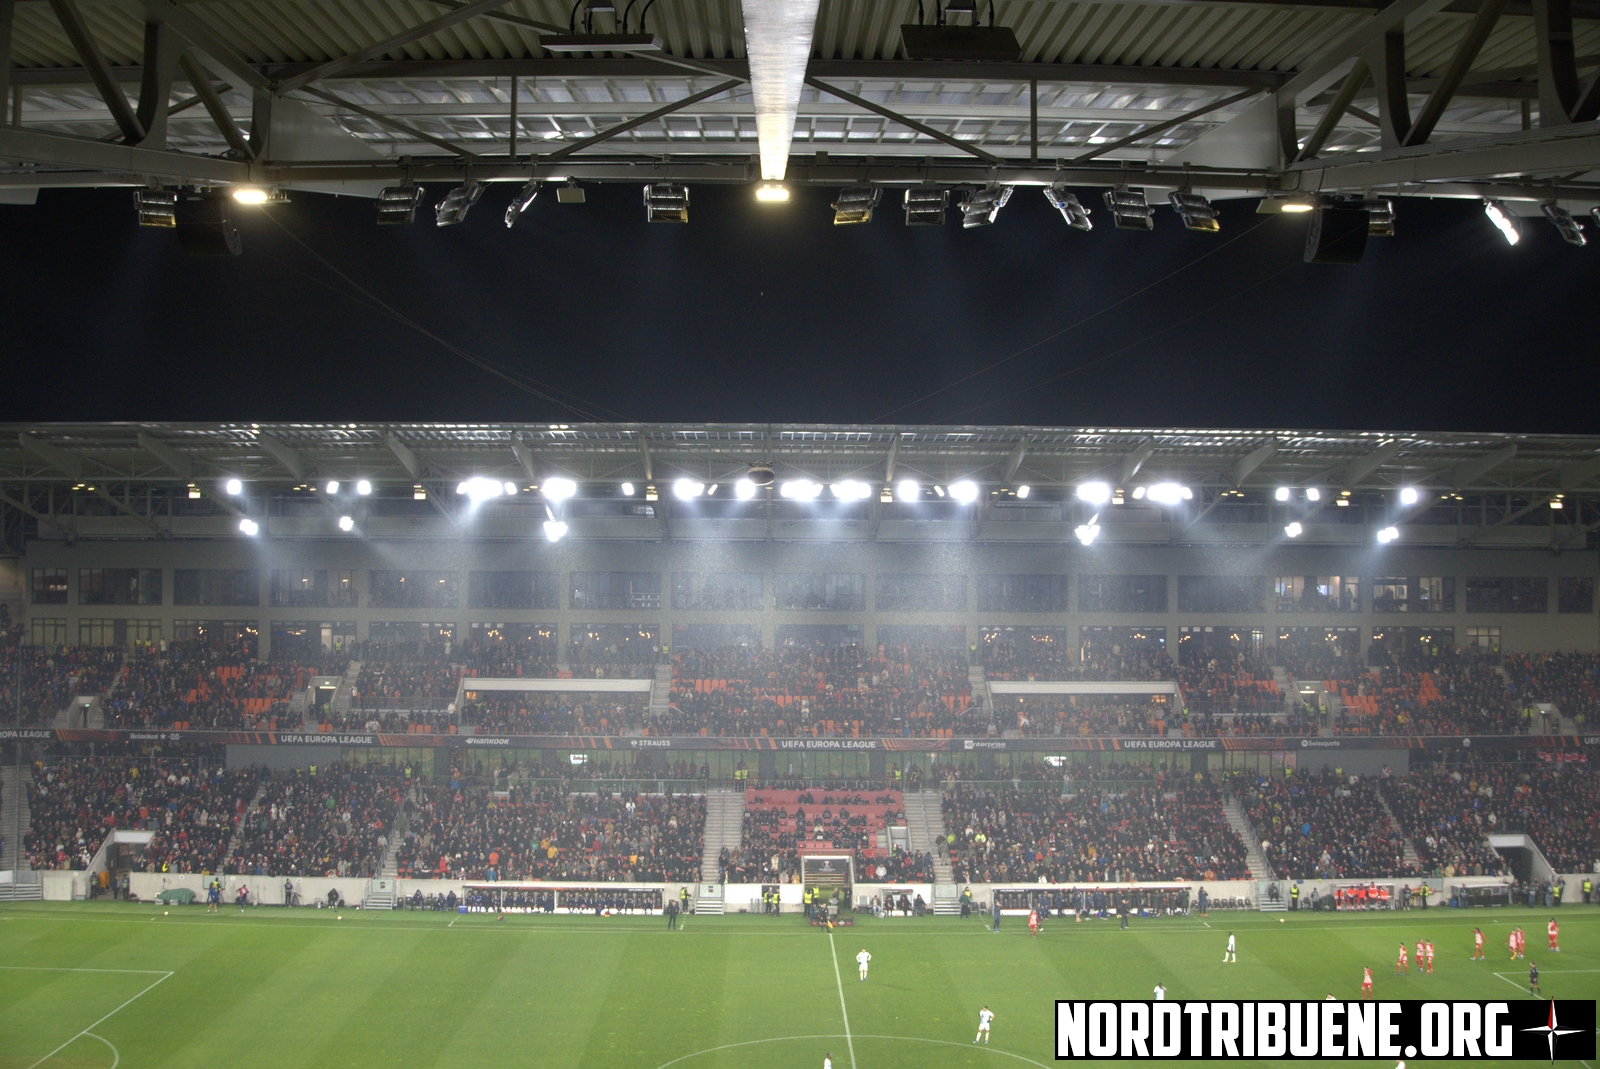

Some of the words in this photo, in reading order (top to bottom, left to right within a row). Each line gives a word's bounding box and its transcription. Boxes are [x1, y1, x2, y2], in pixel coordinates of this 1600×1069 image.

[20, 730, 51, 739] LEAGUE
[130, 732, 159, 740] Heineken
[281, 735, 303, 743] UEFA
[305, 735, 338, 744] EUROPA
[339, 736, 372, 744] LEAGUE
[638, 739, 671, 747] STRAUSS
[1584, 737, 1600, 745] UEF
[781, 740, 805, 748] UEFA
[806, 740, 840, 748] EUROPA
[842, 740, 876, 749] LEAGUE
[1124, 740, 1147, 748] UEFA
[1148, 740, 1182, 748] EUROPA
[1183, 740, 1216, 748] LEAGUE
